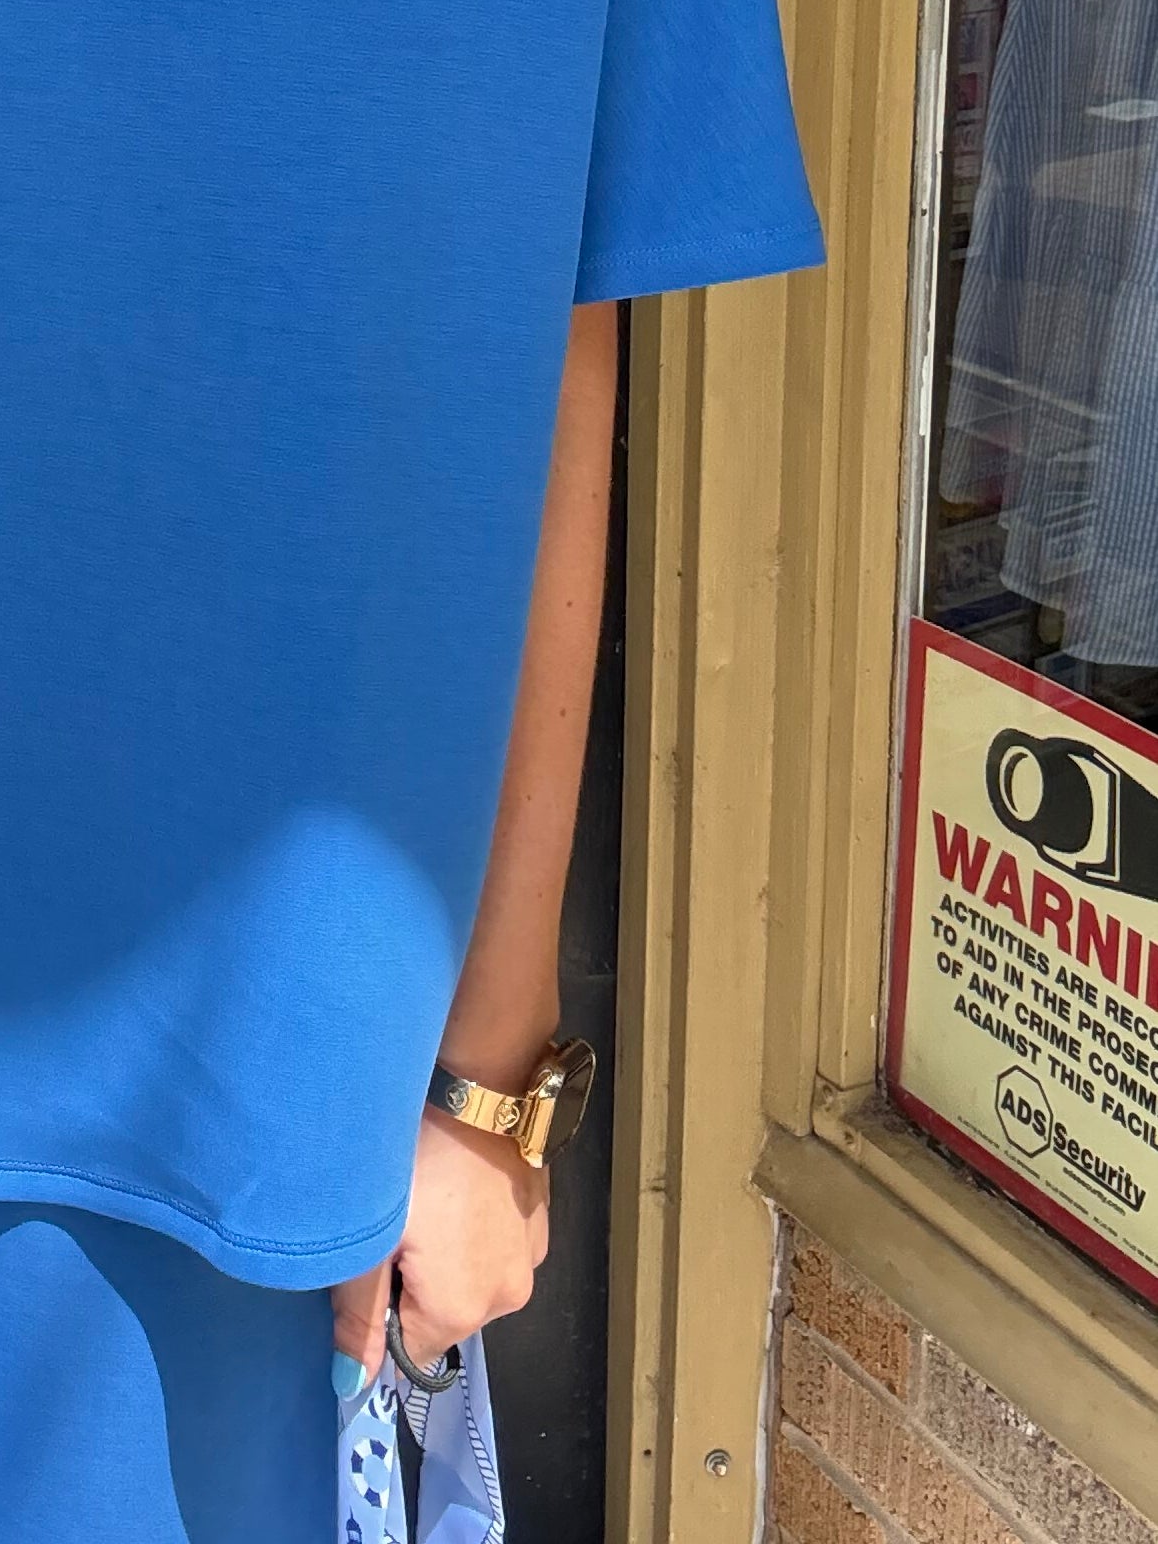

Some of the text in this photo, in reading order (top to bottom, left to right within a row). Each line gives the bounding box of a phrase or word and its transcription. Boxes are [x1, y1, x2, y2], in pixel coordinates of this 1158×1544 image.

[931, 915, 958, 947] TO
[963, 938, 998, 973] AID
[1003, 961, 1024, 992] IN
[1031, 978, 1071, 1024] THE
[937, 951, 963, 980] OF
[968, 971, 1010, 1012] ANY
[1014, 1002, 1081, 1063] CRIME
[939, 893, 1050, 976] ACTIVITIES
[1055, 965, 1098, 1009] ARE
[954, 994, 1042, 1066] AGAINST
[1048, 1054, 1095, 1104] THIS
[1001, 1087, 1047, 1138] ADS
[1053, 1121, 1146, 1211] Security
